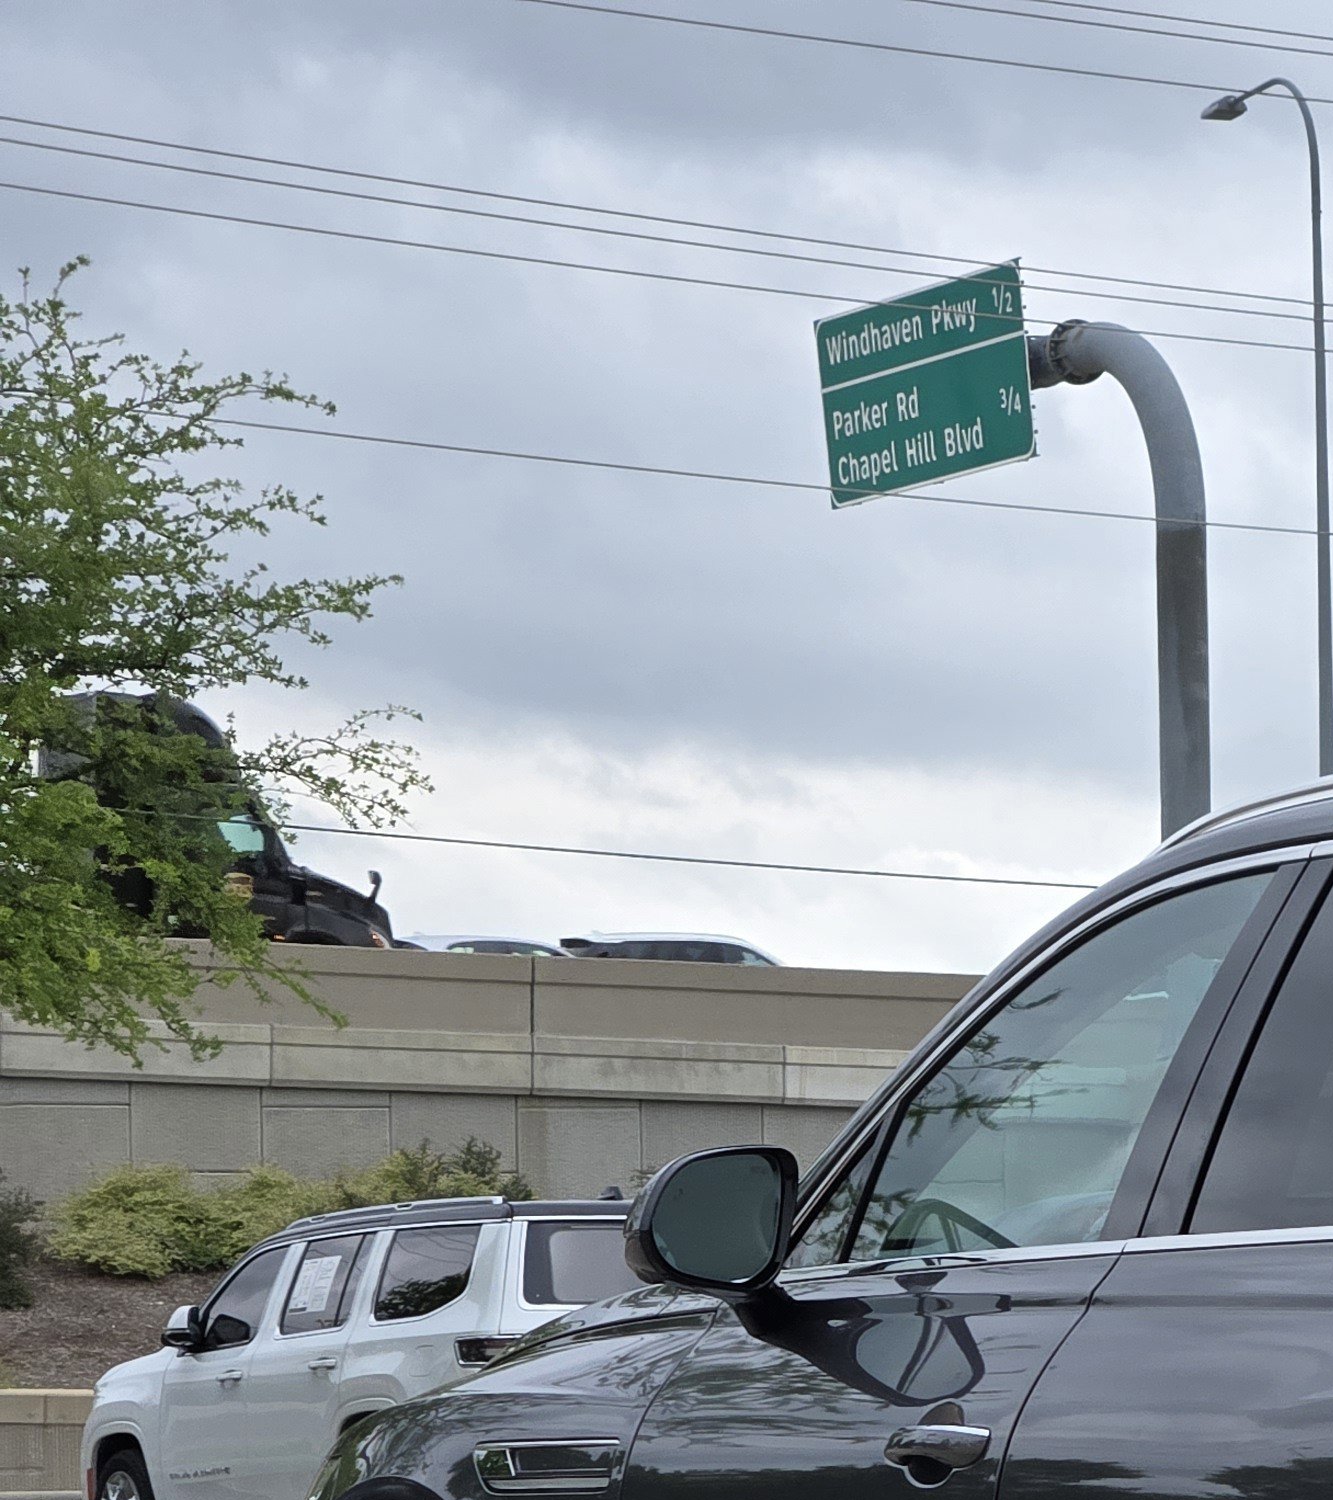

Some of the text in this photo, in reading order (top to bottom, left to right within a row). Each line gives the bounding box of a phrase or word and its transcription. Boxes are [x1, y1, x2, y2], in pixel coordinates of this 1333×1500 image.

[826, 284, 1013, 366] Windhaven Pkwy 1/2
[833, 386, 919, 440] Parker Rd
[999, 385, 1022, 416] 3/4
[838, 417, 984, 485] Chapel Hill Blvd
